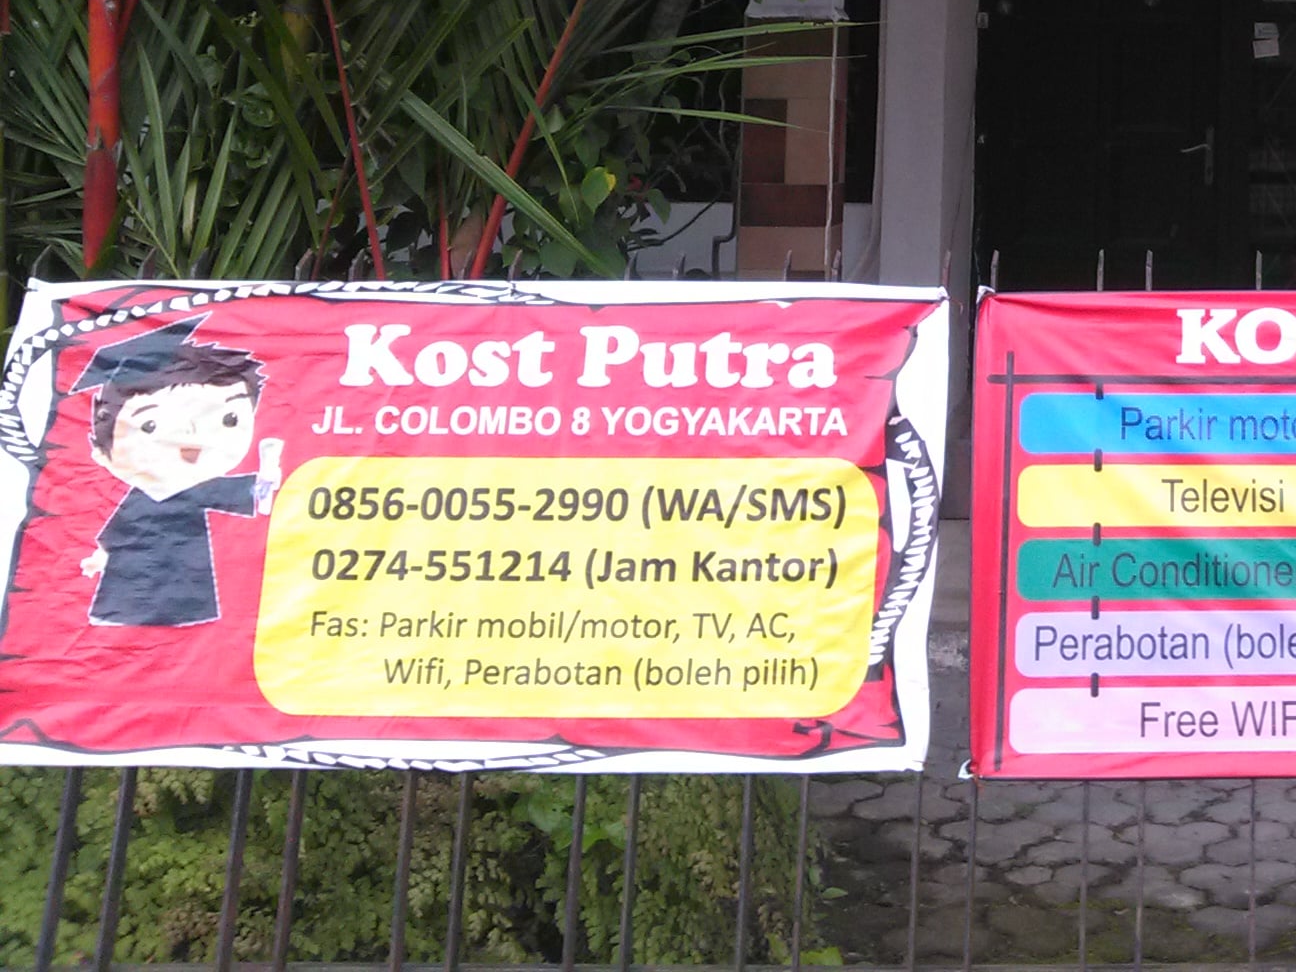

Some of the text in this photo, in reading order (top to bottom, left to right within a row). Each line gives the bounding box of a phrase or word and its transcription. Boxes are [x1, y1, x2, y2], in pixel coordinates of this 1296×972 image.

[339, 323, 838, 389] Kost Putra
[312, 406, 848, 436] JL. COLOMBO 8 YOGYAKARTA
[1120, 406, 1218, 440] Parkir
[307, 484, 847, 530] 0856-0055-2990 (WA/SMS)
[1162, 478, 1284, 513] Televisi
[311, 548, 839, 589] 0274-551214 (Jam Kantor)
[1052, 553, 1100, 588] Air
[310, 609, 796, 644] Fas: Parkir mobil/motor, TV, AC,
[1035, 625, 1210, 661] Perabotan
[384, 657, 819, 691] Wifi, Perabotan (boleh pilih)
[1140, 701, 1219, 737] Free
